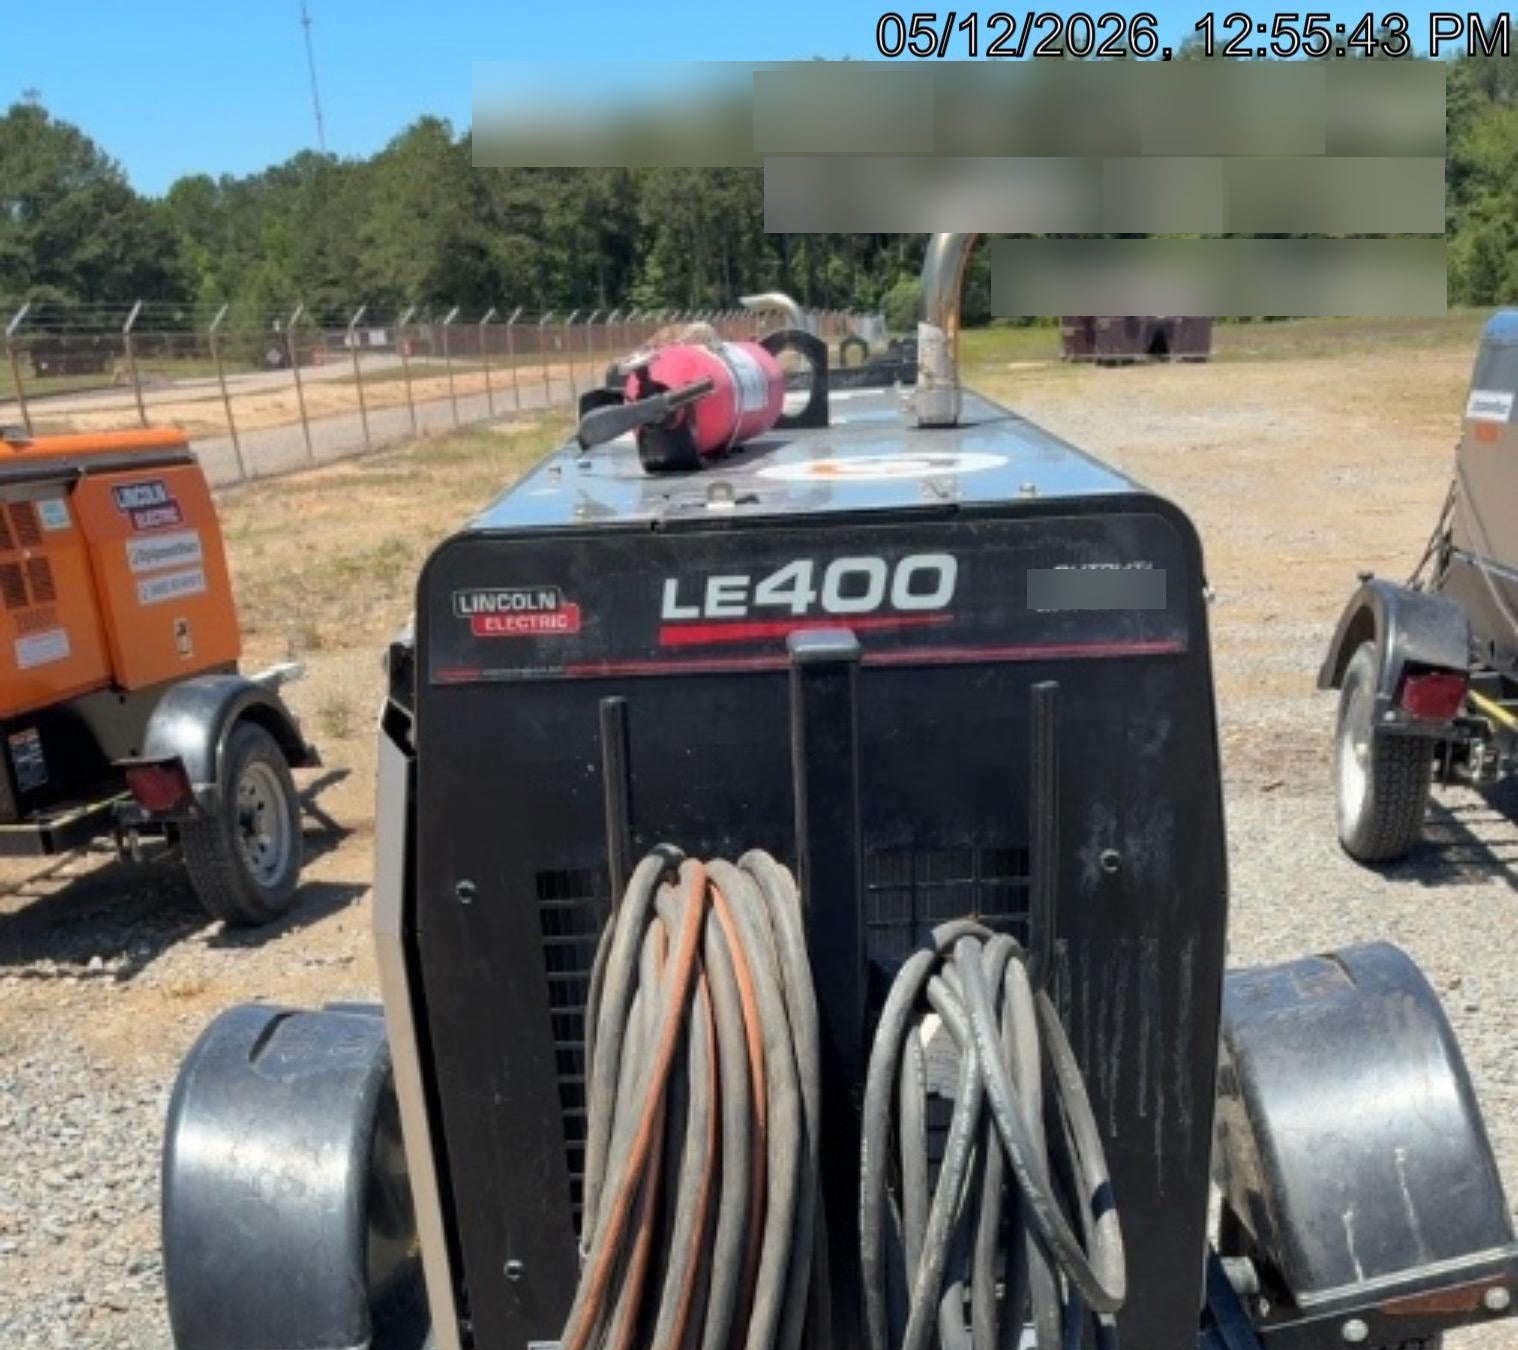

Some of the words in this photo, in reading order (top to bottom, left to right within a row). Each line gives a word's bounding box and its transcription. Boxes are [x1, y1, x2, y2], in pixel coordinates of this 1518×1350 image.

[660, 552, 958, 620] LE400
[459, 590, 557, 614] LINCOLN
[484, 613, 569, 631] ELECTRIC
